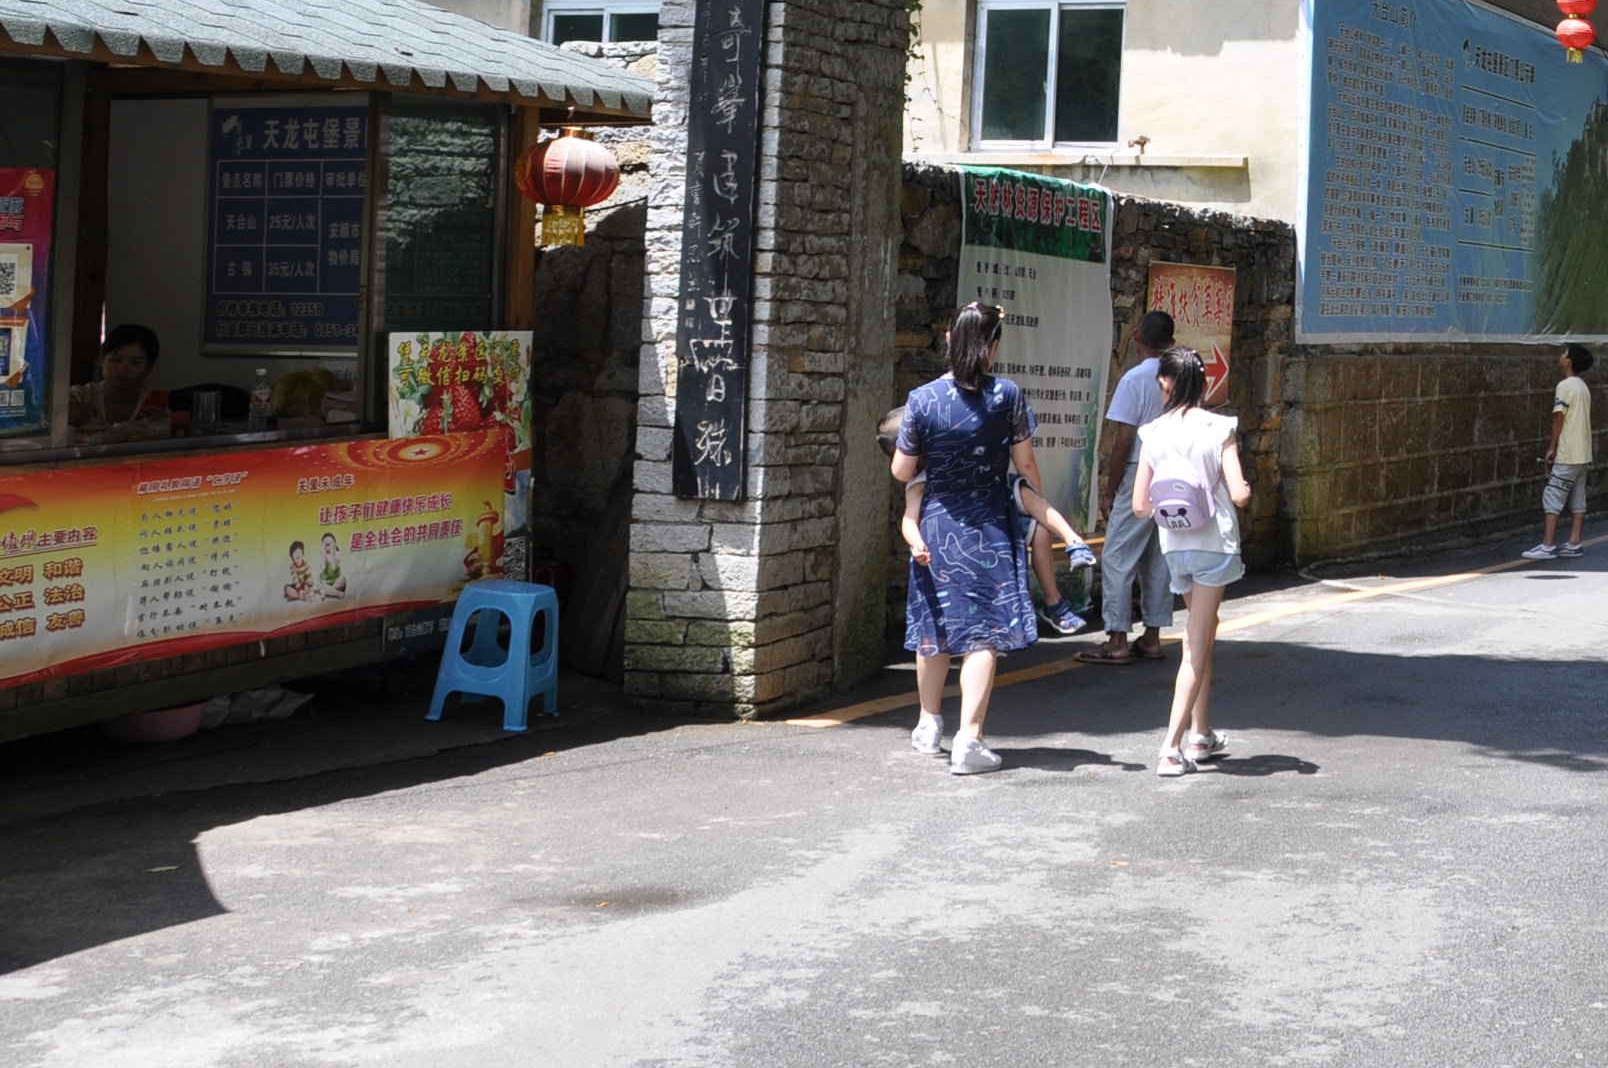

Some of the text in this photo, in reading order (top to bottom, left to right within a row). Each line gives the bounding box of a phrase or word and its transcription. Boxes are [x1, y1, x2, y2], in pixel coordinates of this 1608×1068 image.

[263, 116, 368, 150] 天龙屯堡景
[319, 492, 453, 525] 让孩子们健康快乐成长
[350, 519, 464, 551] 是全社会的共同责任
[43, 558, 83, 580] 和谐
[44, 584, 85, 606] 法治
[46, 608, 86, 631] 友善
